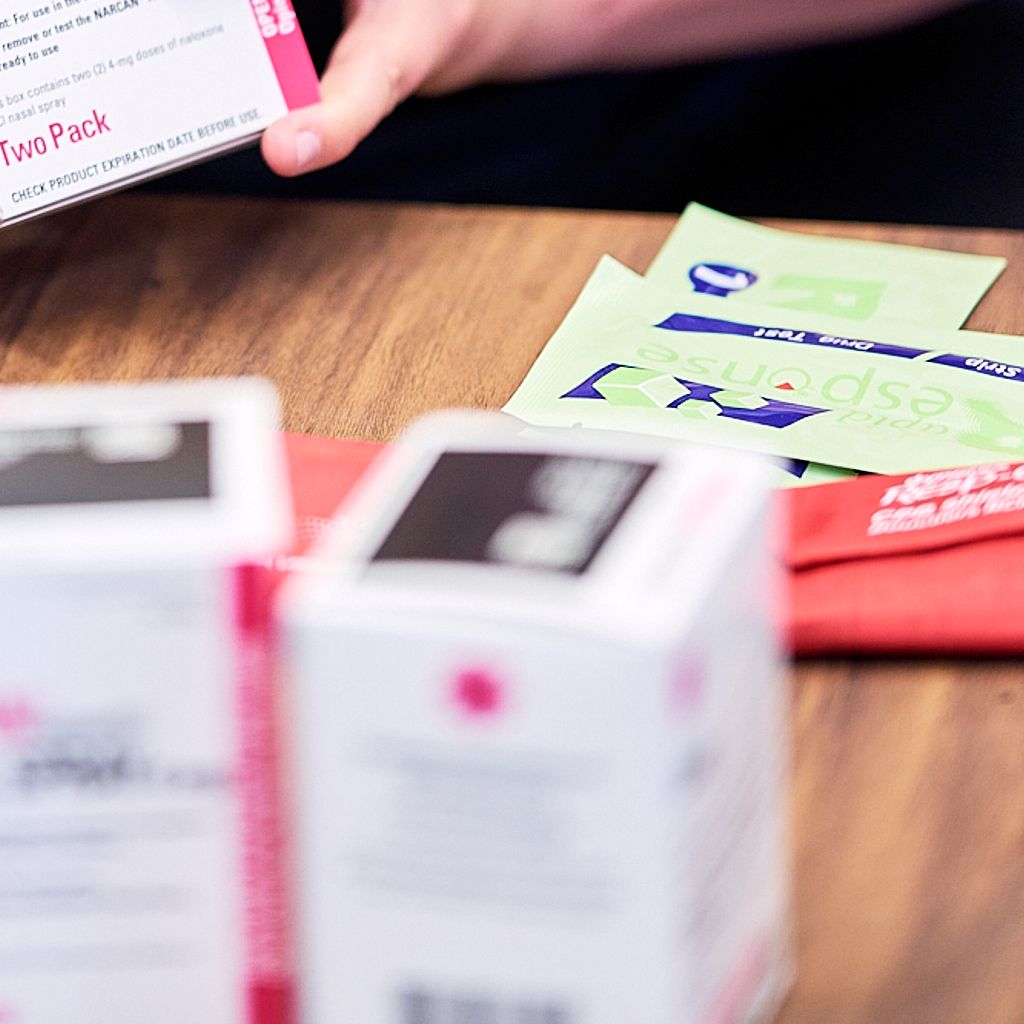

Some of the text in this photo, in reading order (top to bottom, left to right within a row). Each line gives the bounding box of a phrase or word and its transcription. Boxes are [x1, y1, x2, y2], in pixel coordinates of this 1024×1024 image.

[13, 10, 30, 25] For
[32, 5, 51, 19] use
[52, 0, 64, 12] in
[2, 30, 41, 54] remove
[41, 26, 53, 39] or
[54, 18, 74, 34] test
[75, 13, 93, 28] the
[28, 48, 39, 61] to
[40, 42, 60, 57] use
[5, 89, 25, 107] box
[27, 76, 71, 102] contains
[72, 69, 92, 85] two
[93, 62, 108, 78] (2)
[108, 53, 135, 72] 4-mg
[135, 43, 166, 63] doses
[167, 36, 178, 50] of
[177, 22, 225, 47] naloxone
[8, 106, 36, 125] nasal
[37, 96, 67, 116] spray
[48, 108, 112, 150] Pack
[10, 181, 48, 204] CHECK
[49, 163, 101, 192] PRODUCT
[101, 142, 166, 174] EXPIRATION
[167, 130, 197, 153] DATE
[196, 117, 237, 141] BEFORE
[753, 326, 806, 344] Test
[964, 356, 1022, 378] Strip
